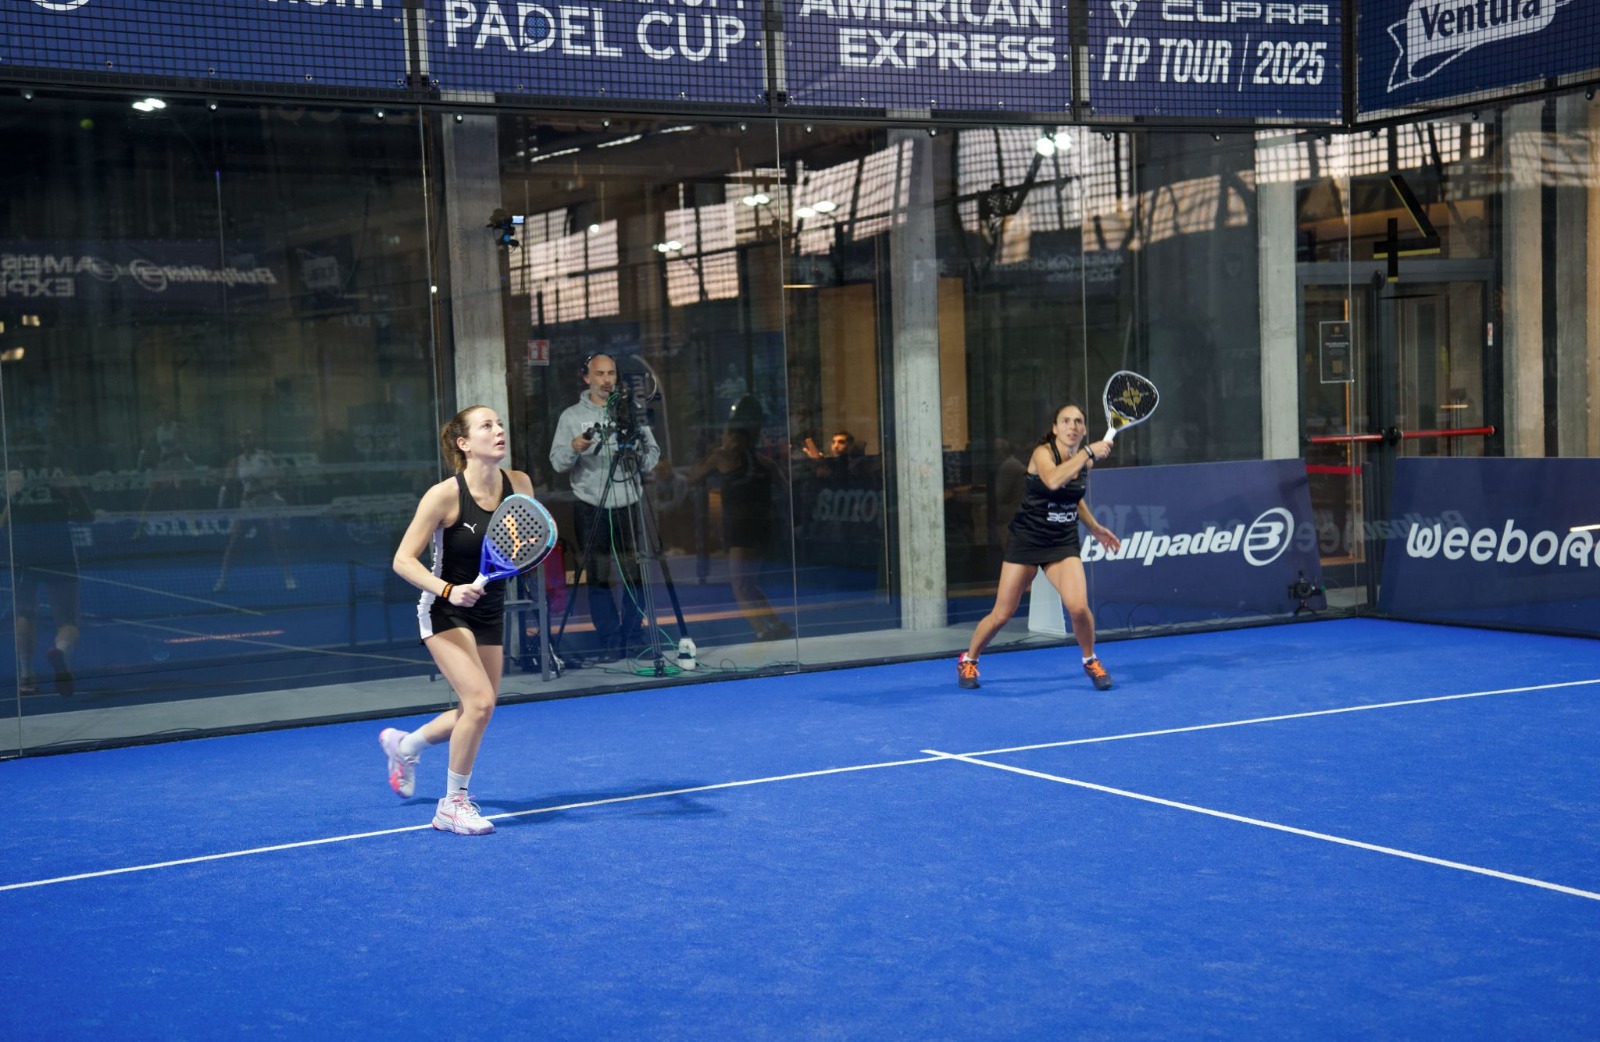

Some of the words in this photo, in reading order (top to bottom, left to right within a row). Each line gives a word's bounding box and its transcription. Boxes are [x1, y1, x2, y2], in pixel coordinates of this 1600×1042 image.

[445, 0, 622, 57] PADEL
[637, 11, 745, 62] CUP
[1162, 0, 1329, 25] CUPRA
[1420, 0, 1540, 40] Ventura
[840, 28, 1056, 73] EXPRESS
[1102, 36, 1150, 81] FIP
[1159, 38, 1232, 83] TOUR
[1253, 41, 1327, 85] 2025
[1080, 524, 1246, 566] Bullpadel
